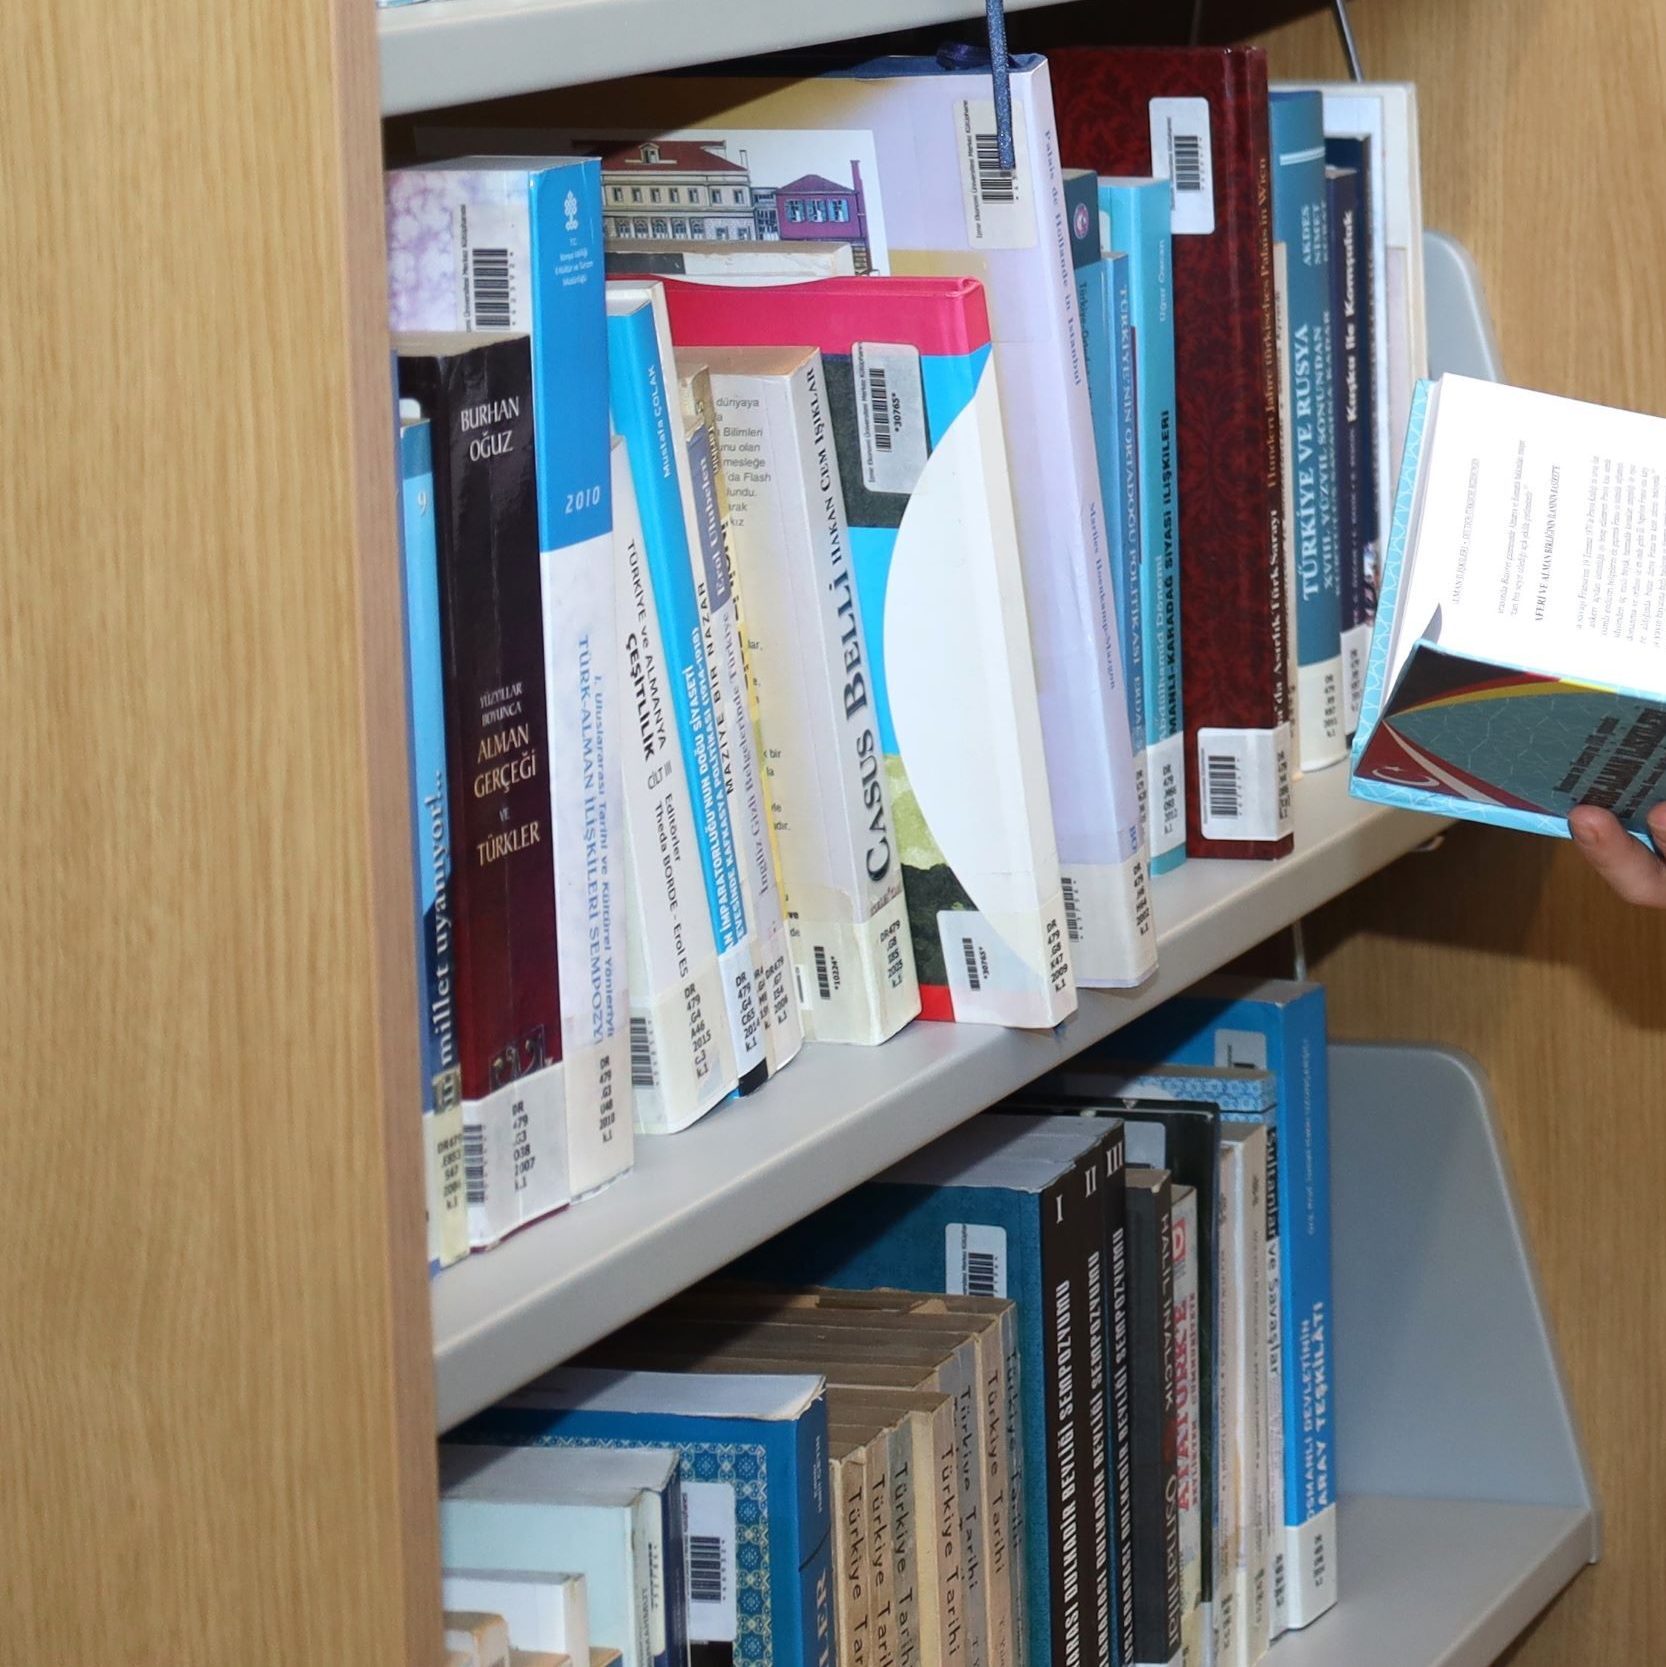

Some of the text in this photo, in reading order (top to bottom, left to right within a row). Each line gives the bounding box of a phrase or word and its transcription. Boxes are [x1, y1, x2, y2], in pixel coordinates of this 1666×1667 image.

[460, 395, 520, 433] BURHAN
[469, 427, 514, 463] OĞUZ
[647, 363, 672, 480] Mustafa ÇOLAK
[723, 427, 763, 438] Bilimleri
[738, 442, 761, 452] olan
[564, 484, 600, 515] 2010
[723, 458, 767, 470] mesleğe
[743, 472, 772, 483] Flash
[806, 367, 843, 566] HAKAN CEM IŞIKLAR
[1161, 409, 1173, 506] İLİŞKİLERİ
[1294, 324, 1319, 602] TÜRKİYE VE RUSYA
[700, 455, 726, 598] Erol Ulubelen
[627, 538, 668, 750] TÜRKİYE ve ALMANYA
[481, 700, 523, 727] BOYUNCA
[625, 632, 655, 762] ÇEŞİTLİLİK
[697, 582, 734, 796] MAZİYE BİR NAZAR
[829, 570, 892, 884] CASUS BELLİ
[473, 748, 537, 800] GERÇEĞİ
[476, 722, 530, 765] ALMAN
[579, 634, 599, 921] TÜRK-ALMAN İLİŞKİLERİ
[499, 806, 510, 823] VE
[664, 792, 681, 863] Editörler
[682, 665, 731, 934] İMPARATORLUĞU'NUN DOĞU SİYASETİ
[476, 820, 541, 867] TÜRKLER
[654, 799, 686, 957] Theda BORDE Erol
[686, 995, 701, 1013] 479
[735, 970, 748, 988] DR
[1051, 964, 1069, 983] 2009
[432, 967, 452, 1065] millet
[691, 1021, 706, 1039] A46
[692, 1032, 712, 1053] 2015
[1085, 1164, 1098, 1198] II
[1106, 1137, 1124, 1178] III
[1056, 1279, 1073, 1422] SEMPOZYUMU
[958, 1384, 979, 1590] Türkiye Tarihi
[986, 1368, 1006, 1574] Türkiye Tarihi
[847, 1485, 863, 1601] Türkiye
[871, 1473, 886, 1586] Türkiye
[894, 1461, 908, 1574] Türkiye
[939, 1443, 962, 1657] Türkiye Tarihi
